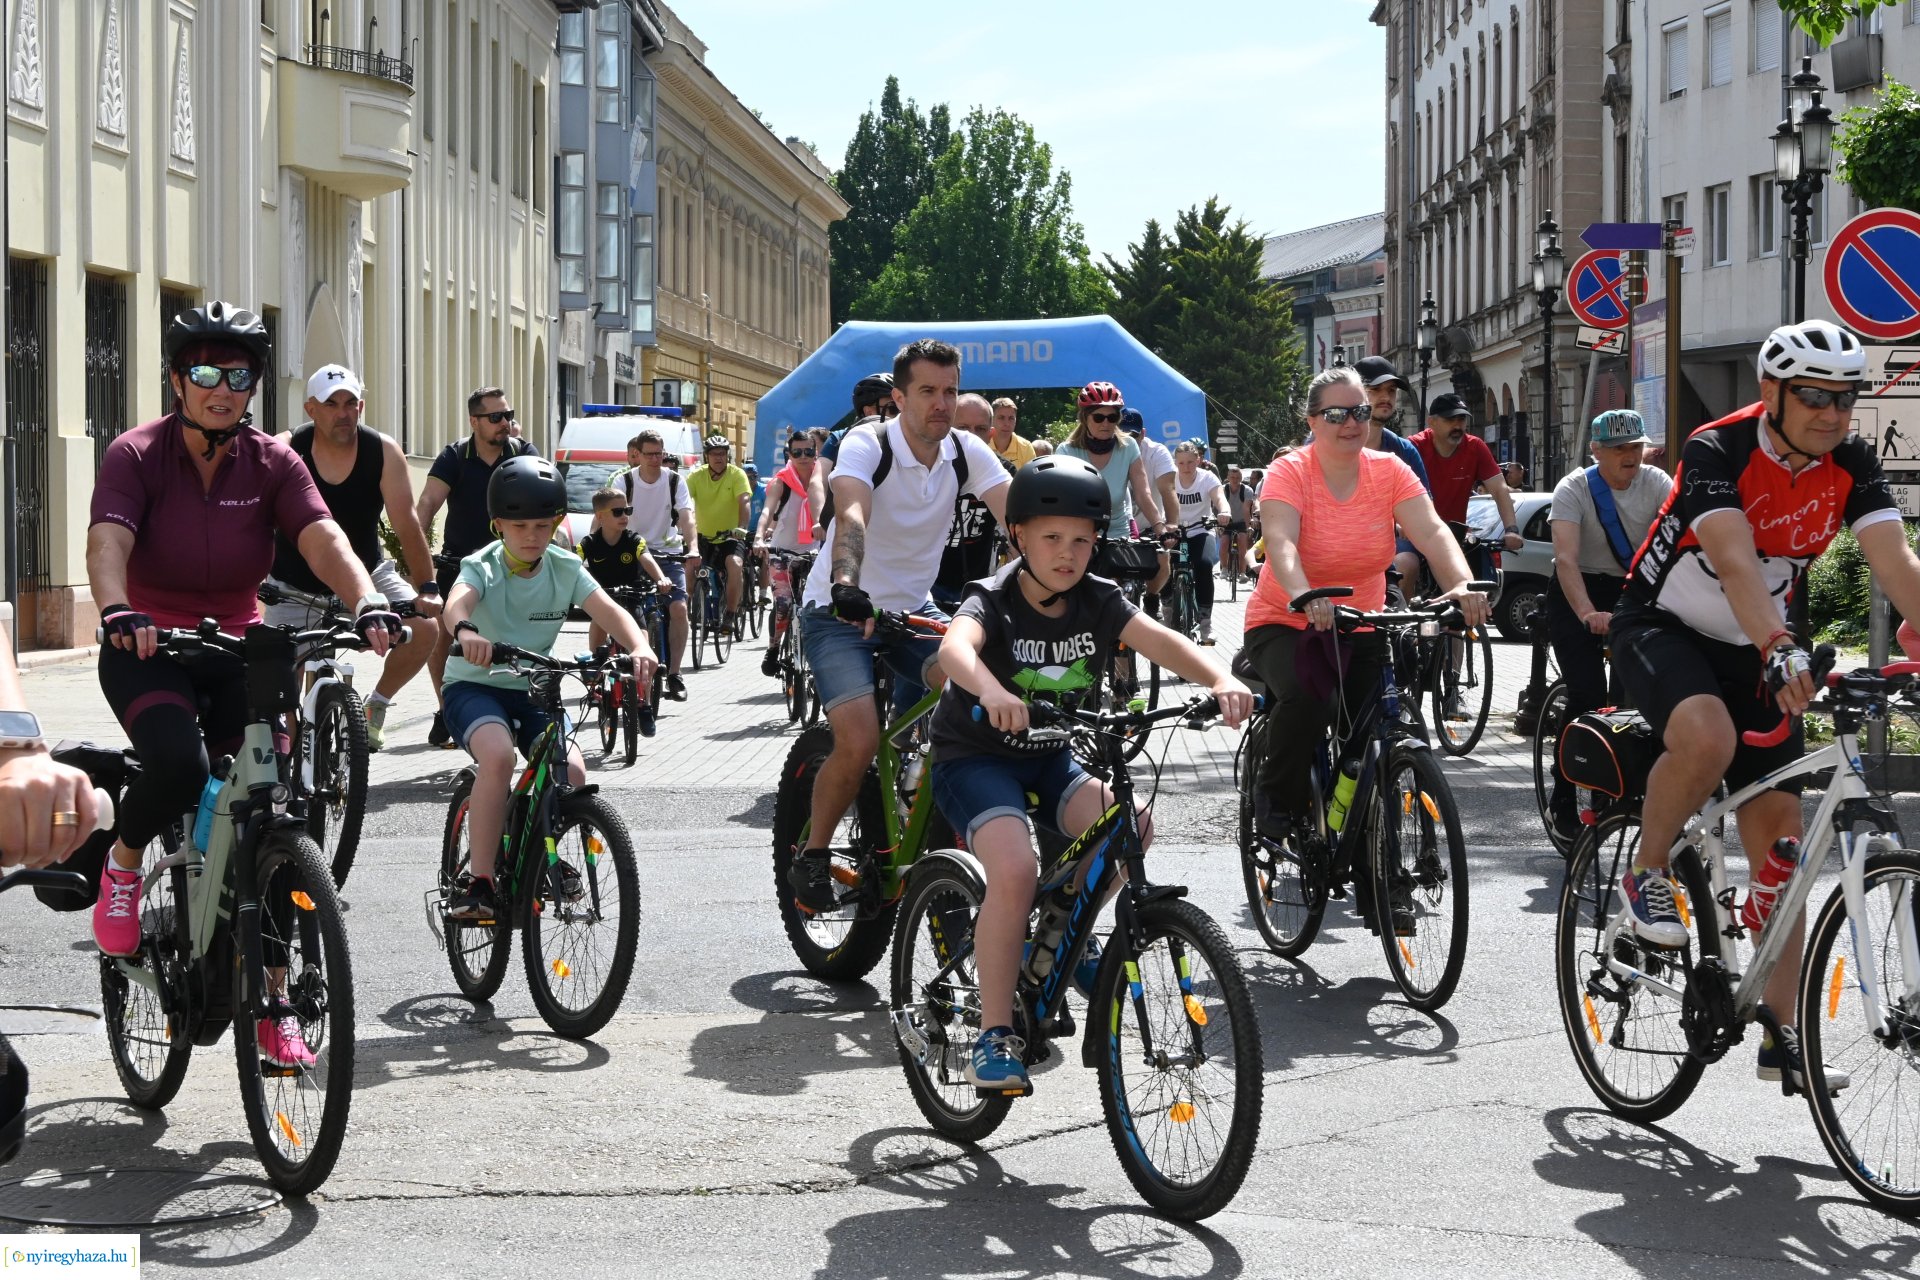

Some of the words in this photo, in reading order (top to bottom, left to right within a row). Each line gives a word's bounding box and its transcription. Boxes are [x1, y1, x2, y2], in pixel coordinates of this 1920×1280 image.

[958, 340, 1053, 364] MANO
[1891, 487, 1908, 496] LAG
[219, 496, 260, 506] KELLYS
[1052, 632, 1097, 664] VIBES
